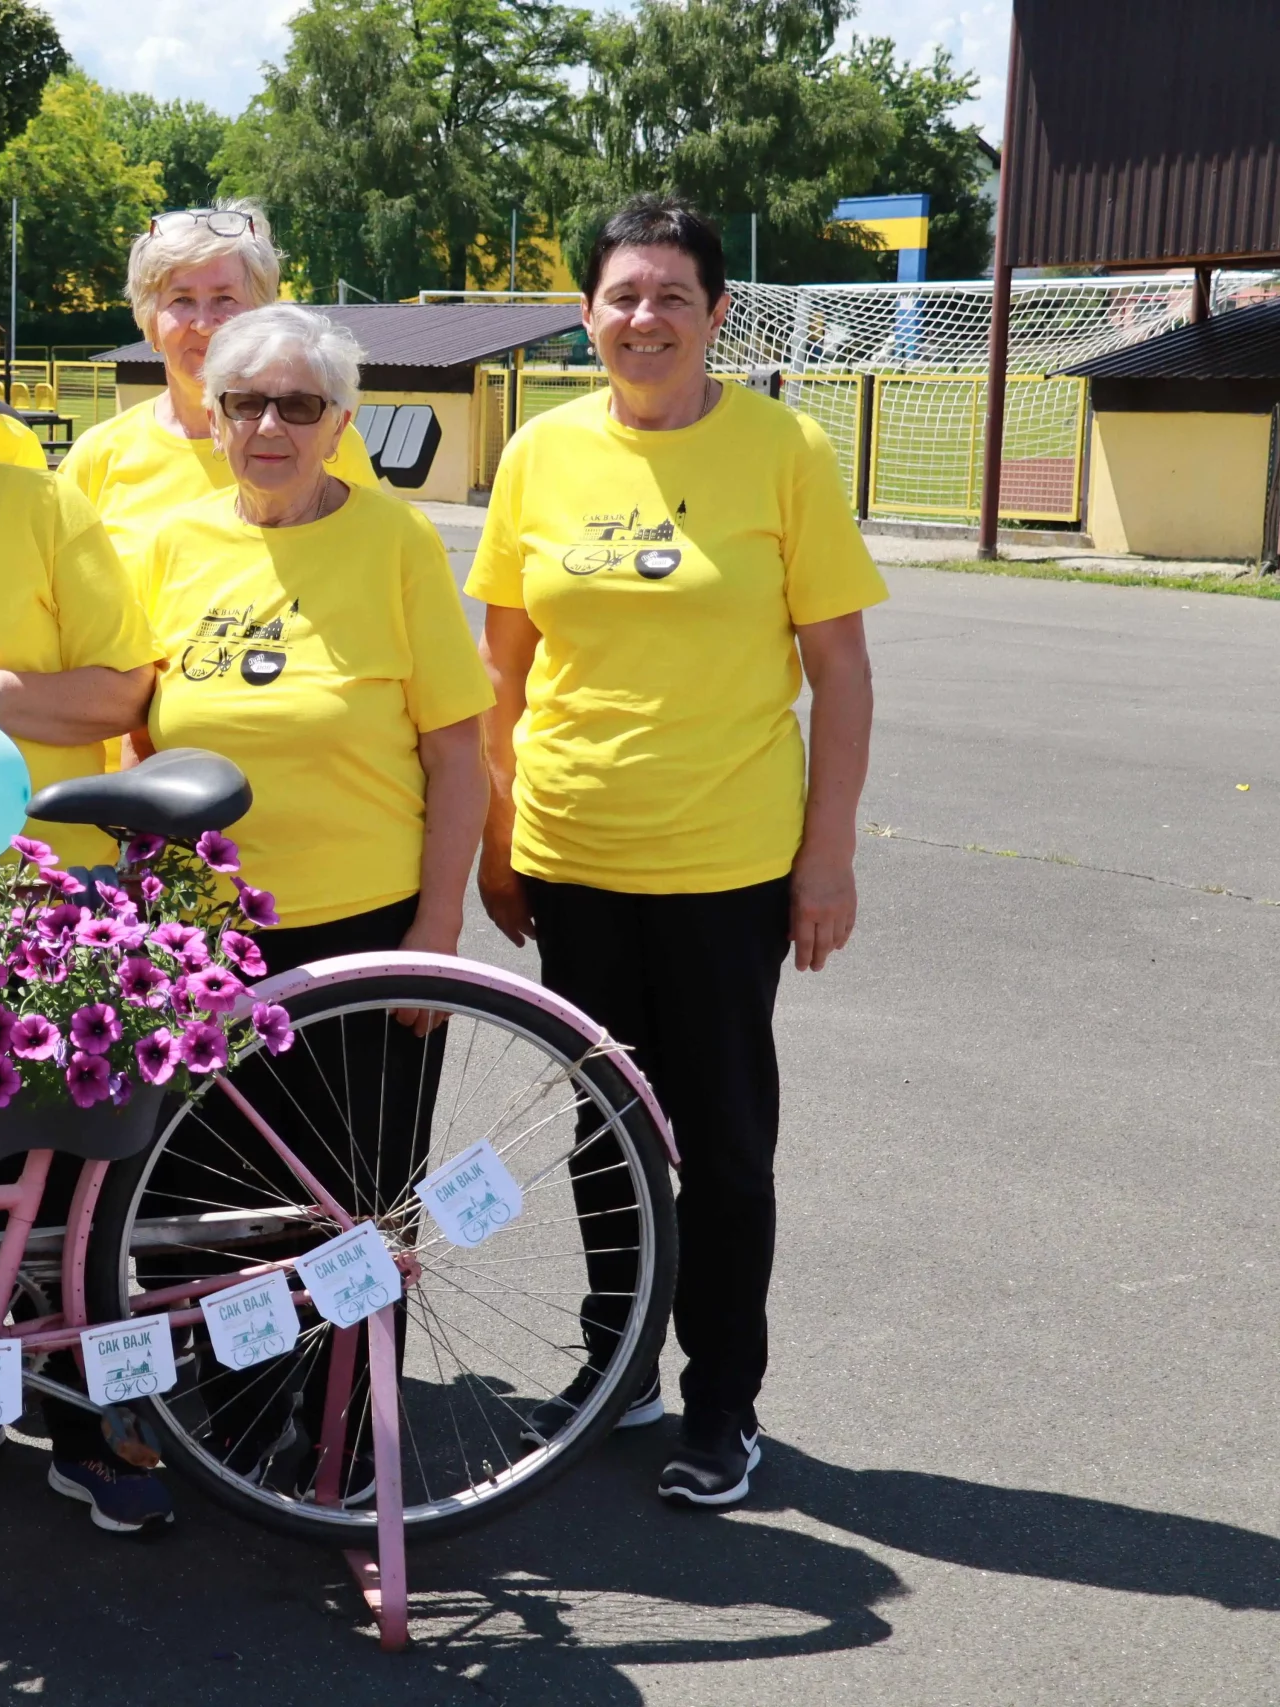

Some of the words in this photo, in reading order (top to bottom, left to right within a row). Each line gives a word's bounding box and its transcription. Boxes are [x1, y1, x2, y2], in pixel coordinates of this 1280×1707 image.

[455, 1162, 485, 1189] BAJK
[337, 1243, 367, 1268] BAJK
[243, 1291, 273, 1312] BAJK
[123, 1331, 152, 1350] BAJK
